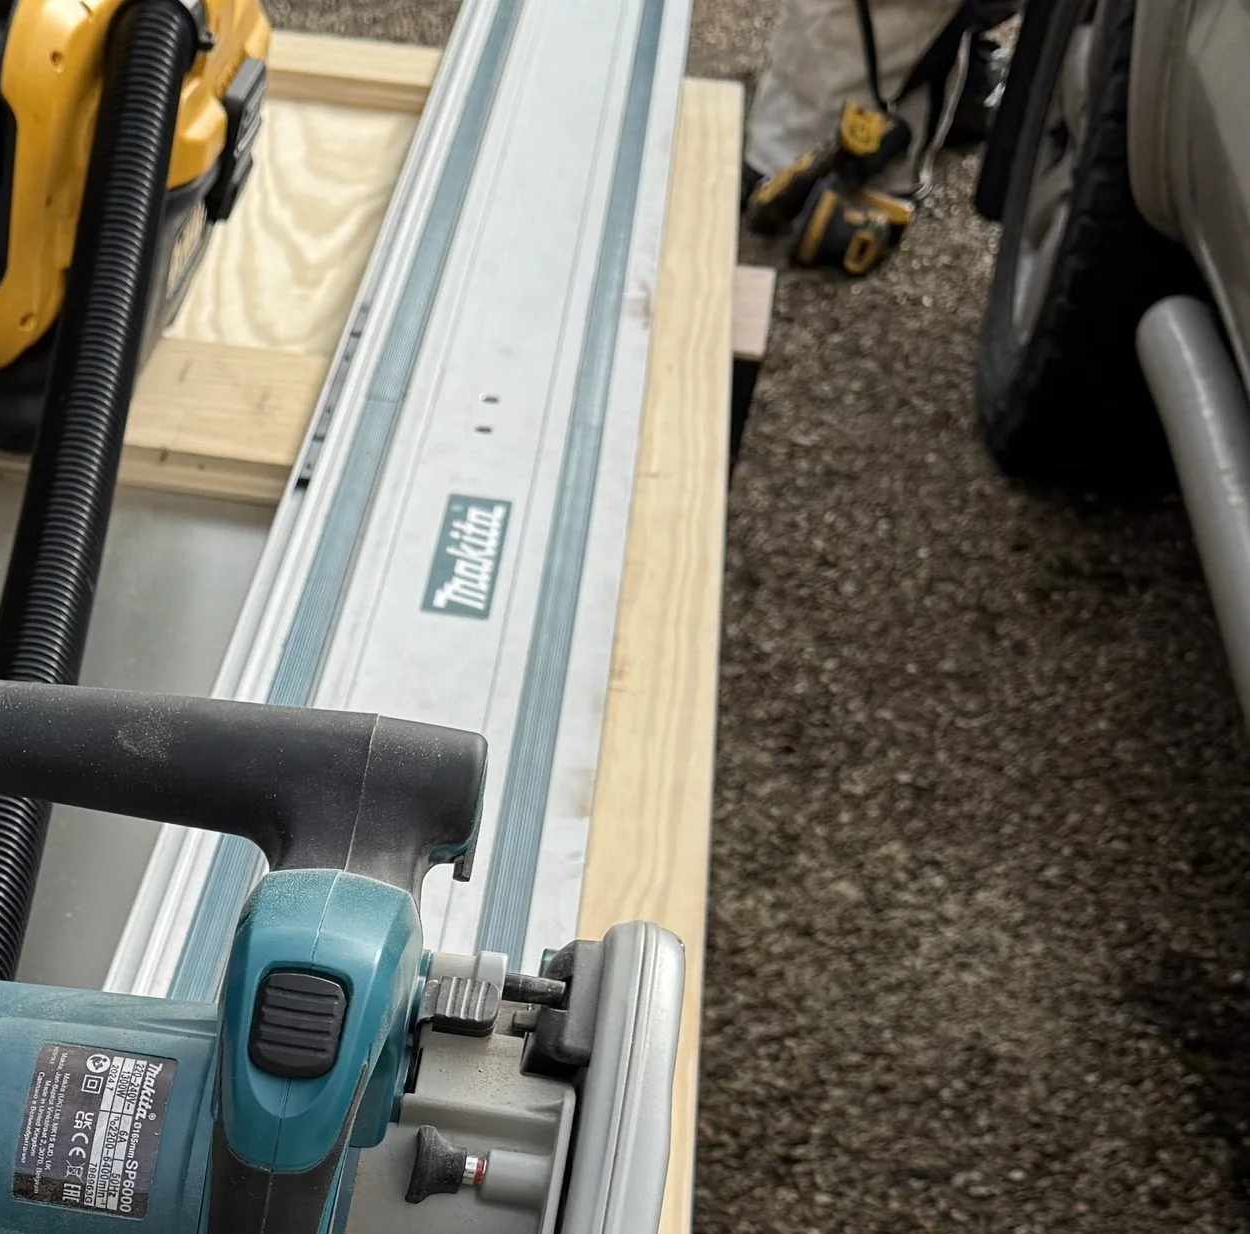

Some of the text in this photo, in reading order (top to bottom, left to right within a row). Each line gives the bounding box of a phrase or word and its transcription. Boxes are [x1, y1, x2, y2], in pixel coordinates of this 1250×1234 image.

[116, 1071, 130, 1098] 1300W
[74, 1111, 84, 1129] CA
[85, 1112, 94, 1129] UK
[118, 1131, 128, 1143] 6A
[108, 1173, 120, 1197] 50Hz
[120, 1160, 138, 1212] SP6000
